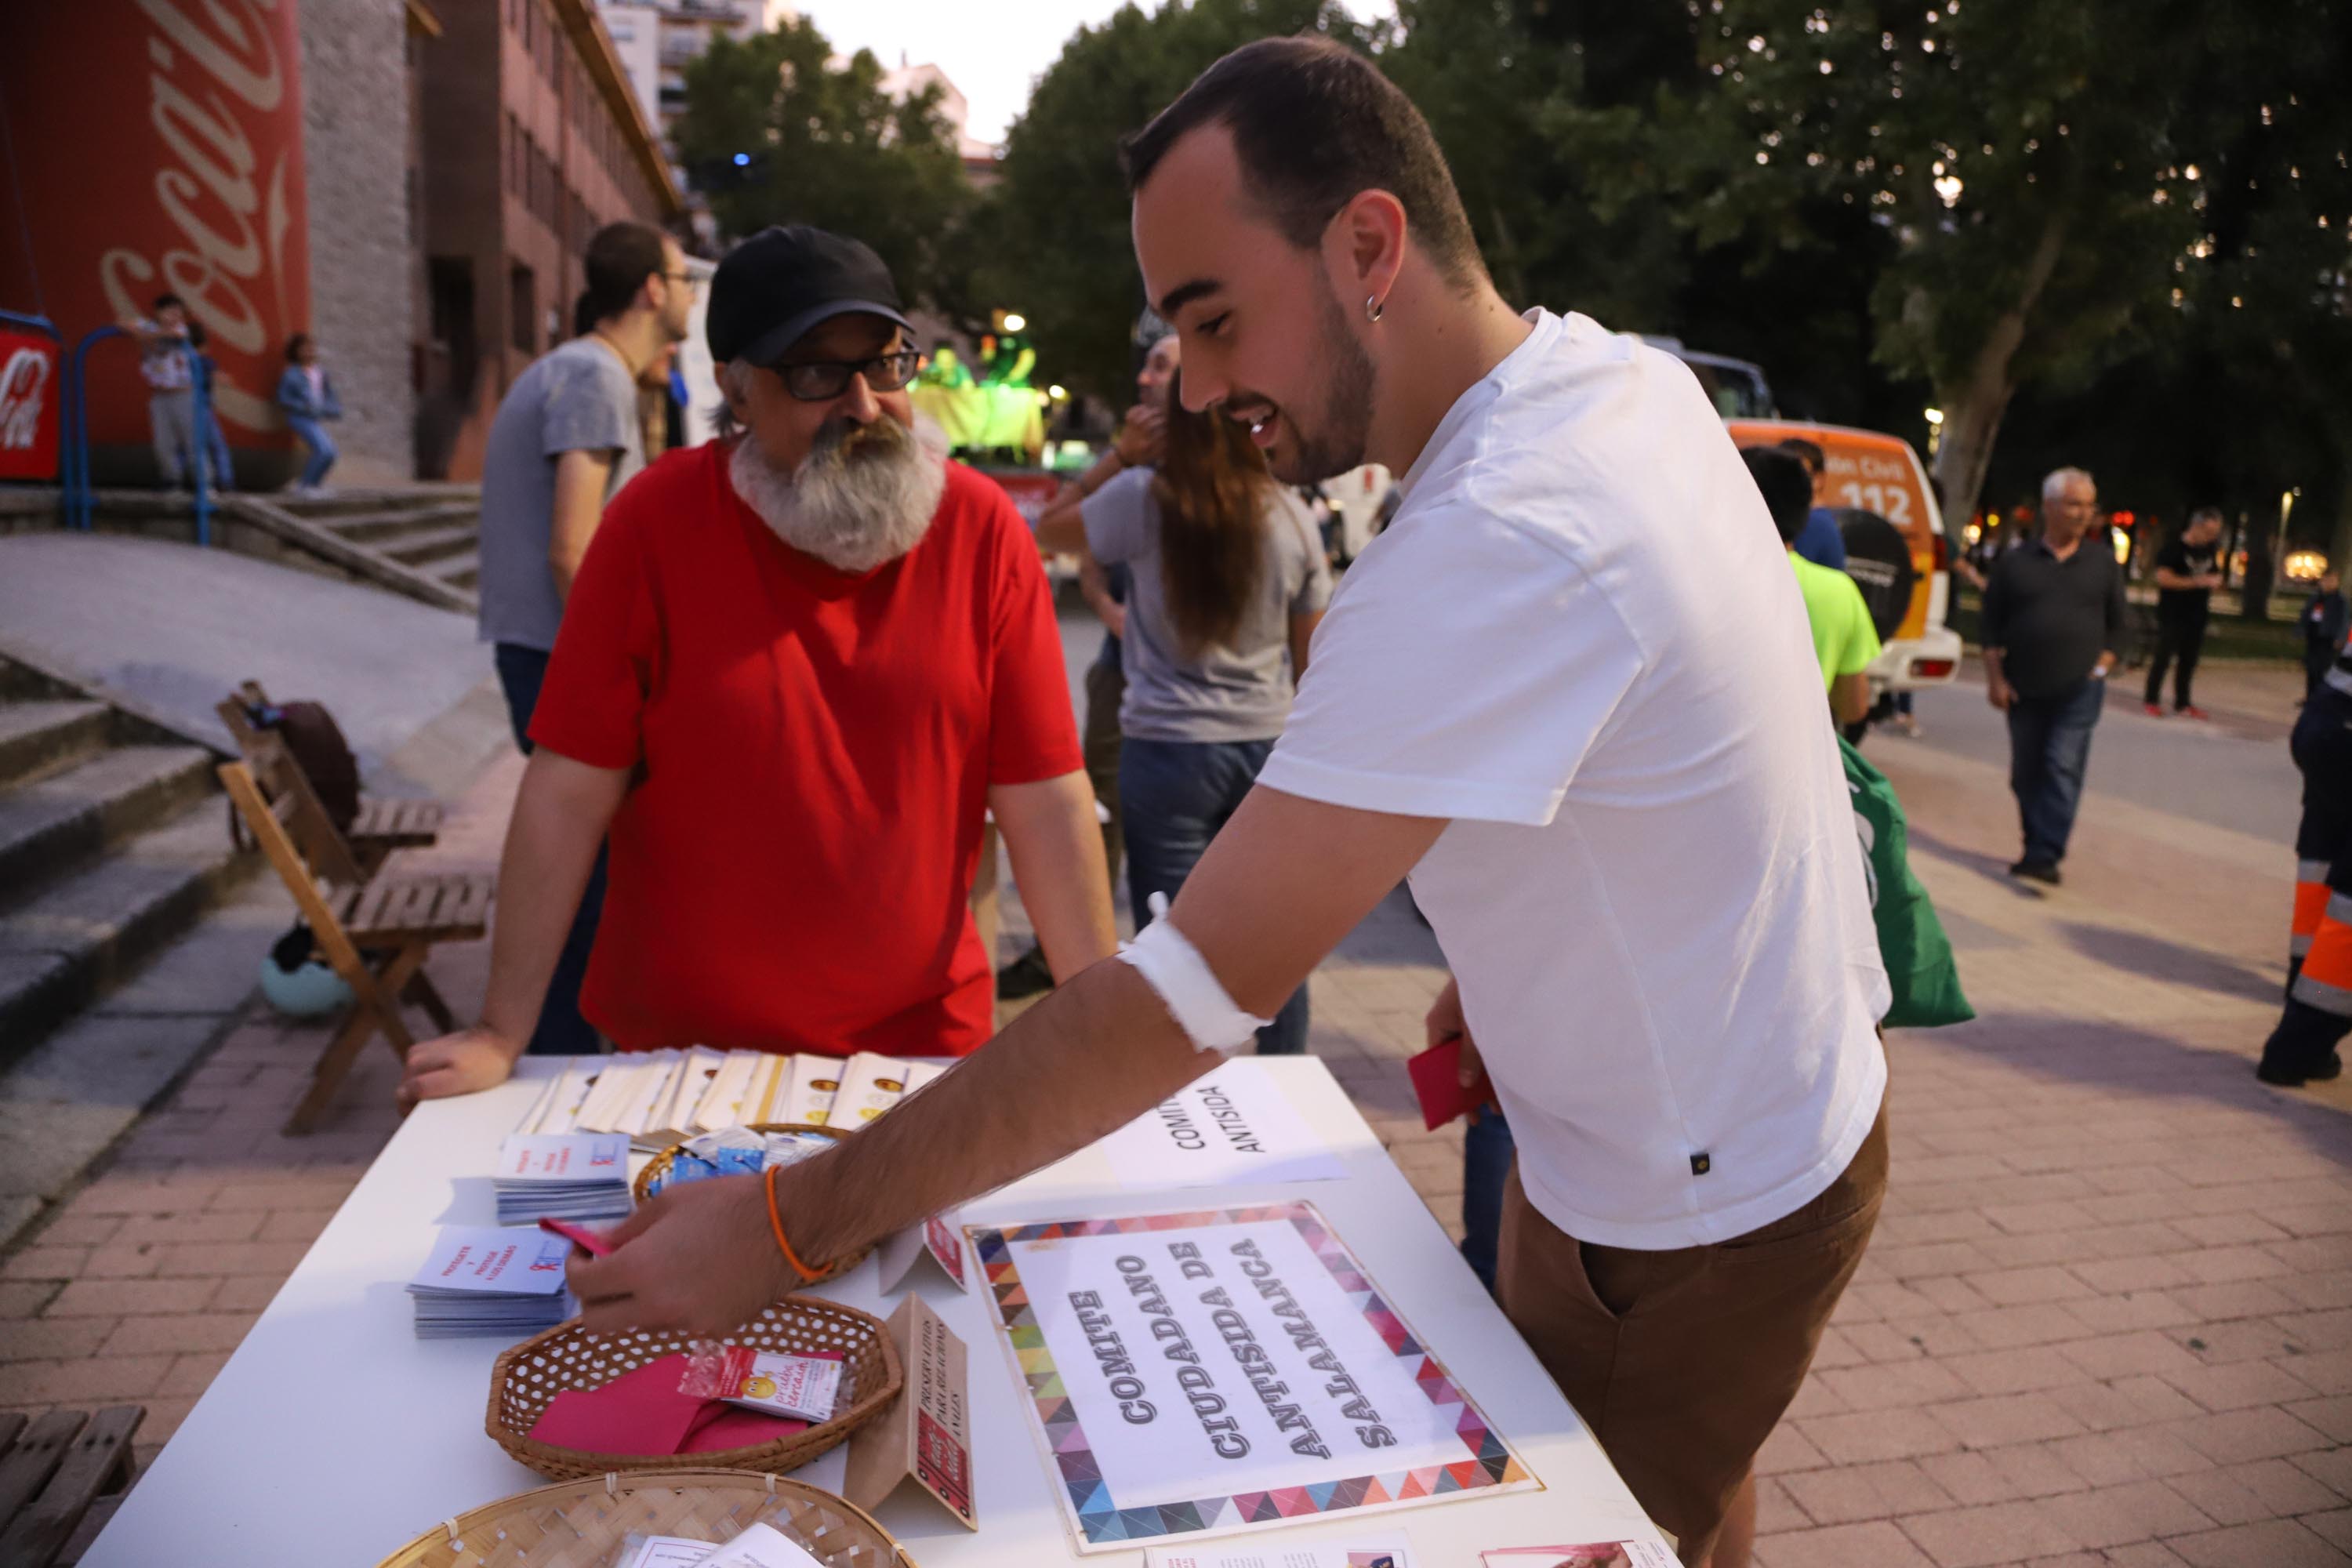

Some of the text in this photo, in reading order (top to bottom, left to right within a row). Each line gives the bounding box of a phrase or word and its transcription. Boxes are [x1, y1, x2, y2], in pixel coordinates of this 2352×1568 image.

[1841, 481, 1913, 526] 112
[1157, 1102, 1206, 1150] COMIT
[1196, 1085, 1266, 1153] ANTISIDA
[1167, 1241, 1214, 1280] DE
[1068, 1290, 1158, 1425] COMITE
[1115, 1255, 1251, 1460] CIUDADANO
[1199, 1287, 1332, 1461] ANTISIDA
[1230, 1238, 1399, 1450] SALAMANCA
